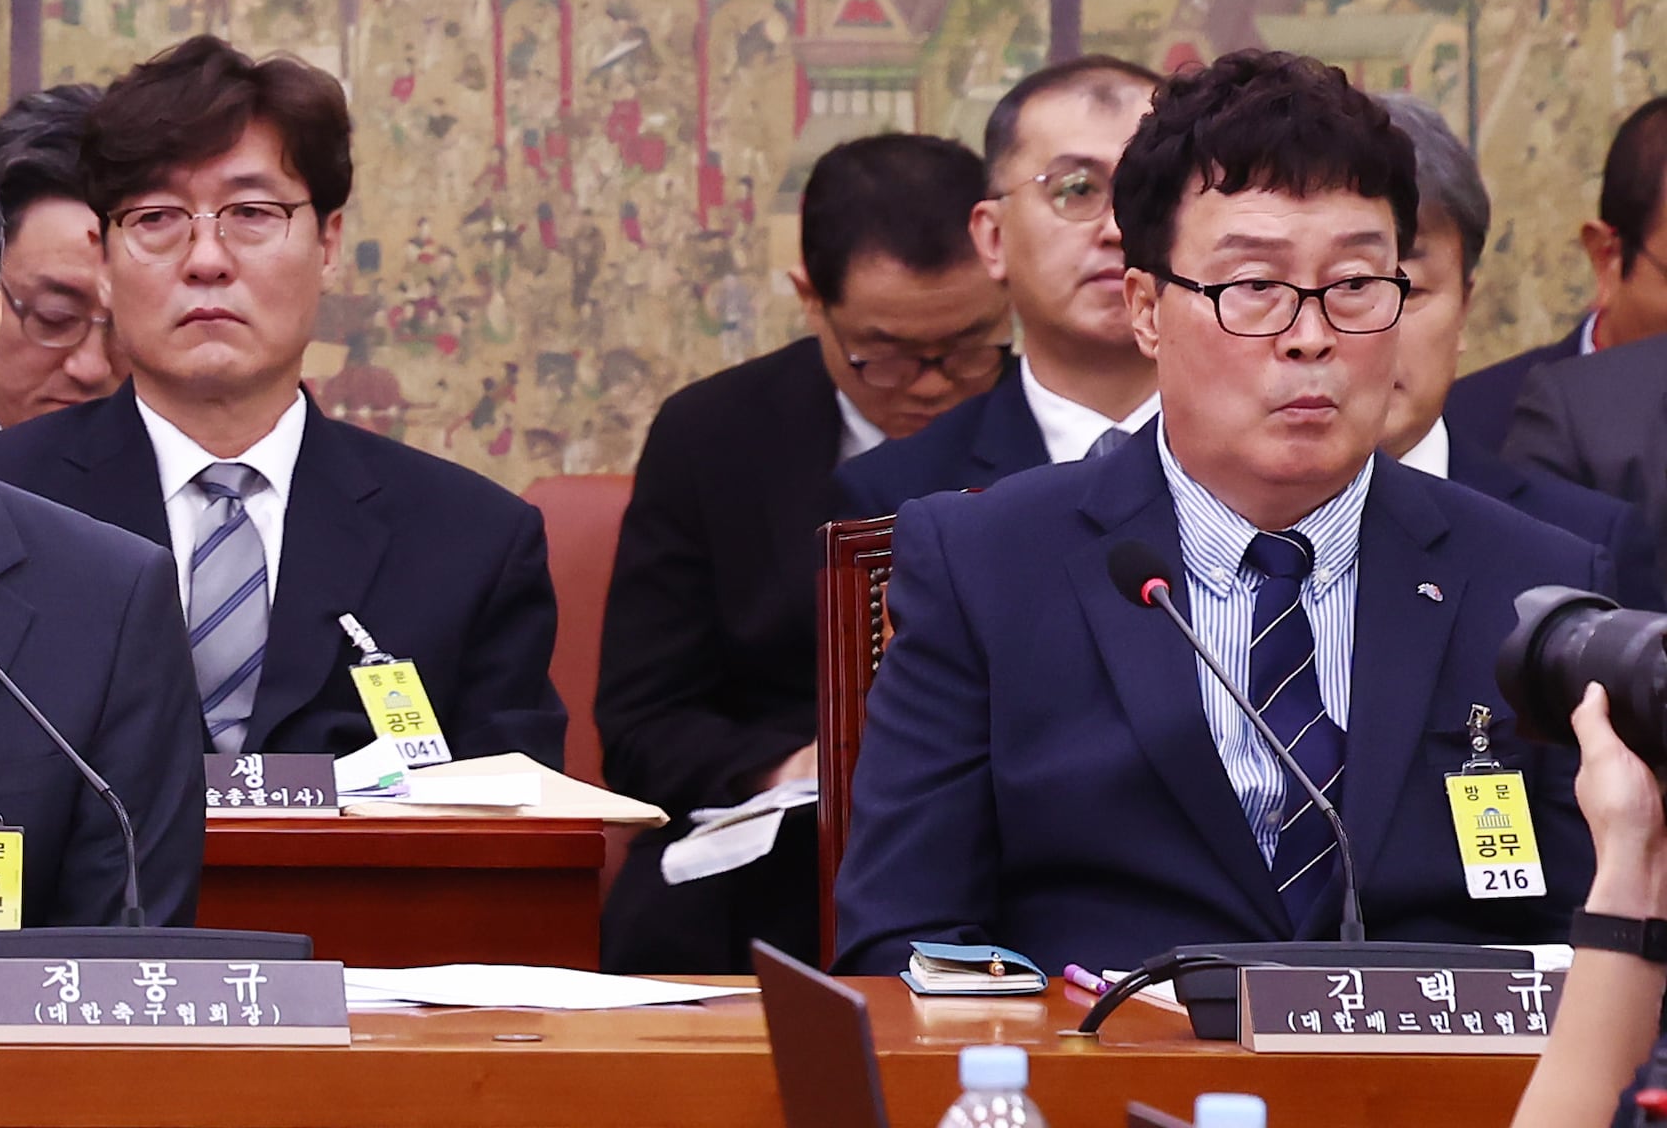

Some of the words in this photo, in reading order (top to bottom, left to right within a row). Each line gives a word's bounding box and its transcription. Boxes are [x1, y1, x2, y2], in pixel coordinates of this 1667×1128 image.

[386, 712, 424, 733] 공무
[230, 753, 264, 788] 생
[1464, 784, 1509, 801] 방문
[1475, 834, 1521, 857] 공무
[1483, 868, 1528, 890] 216
[42, 960, 268, 1002] 정몽규
[1327, 969, 1552, 1013] 김택규
